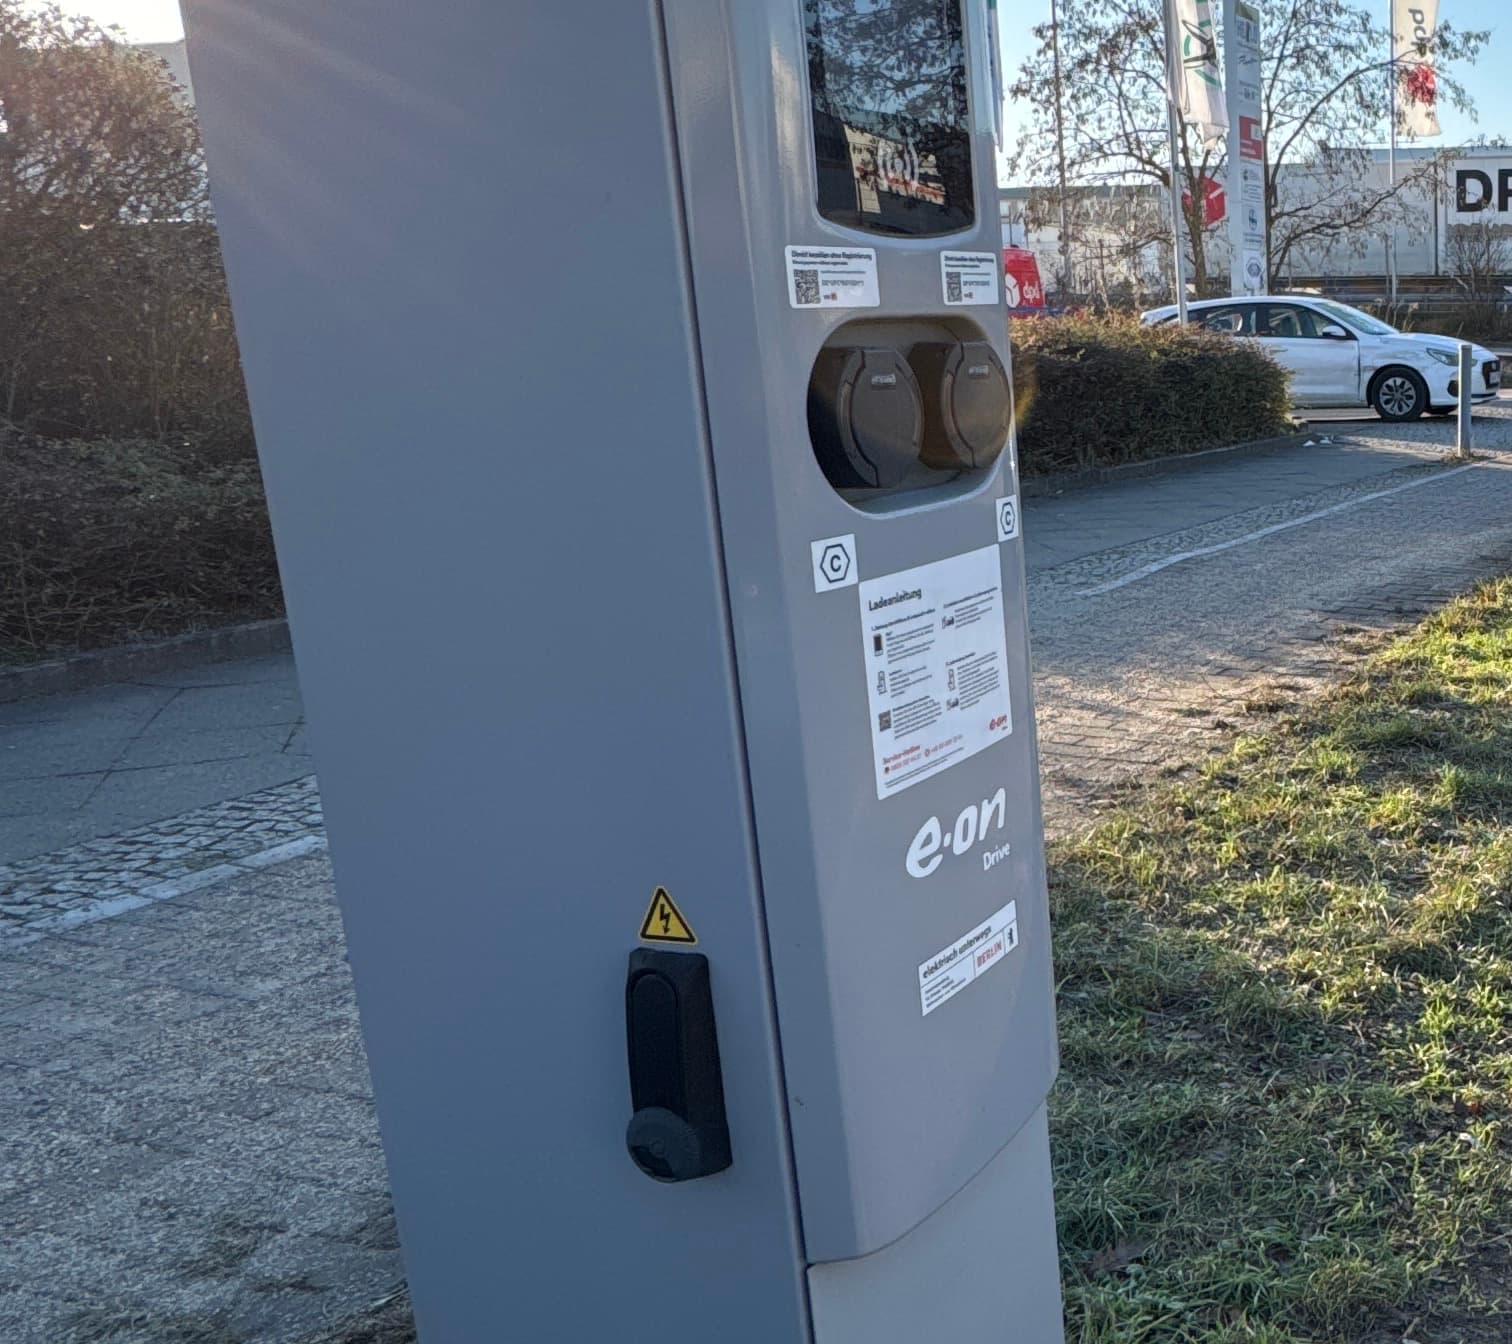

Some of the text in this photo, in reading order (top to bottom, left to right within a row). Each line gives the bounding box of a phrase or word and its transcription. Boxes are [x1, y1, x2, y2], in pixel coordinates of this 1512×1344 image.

[868, 589, 922, 611] Ladeanleitung
[983, 843, 1010, 871] Drive
[976, 940, 1002, 968] BERLIN
